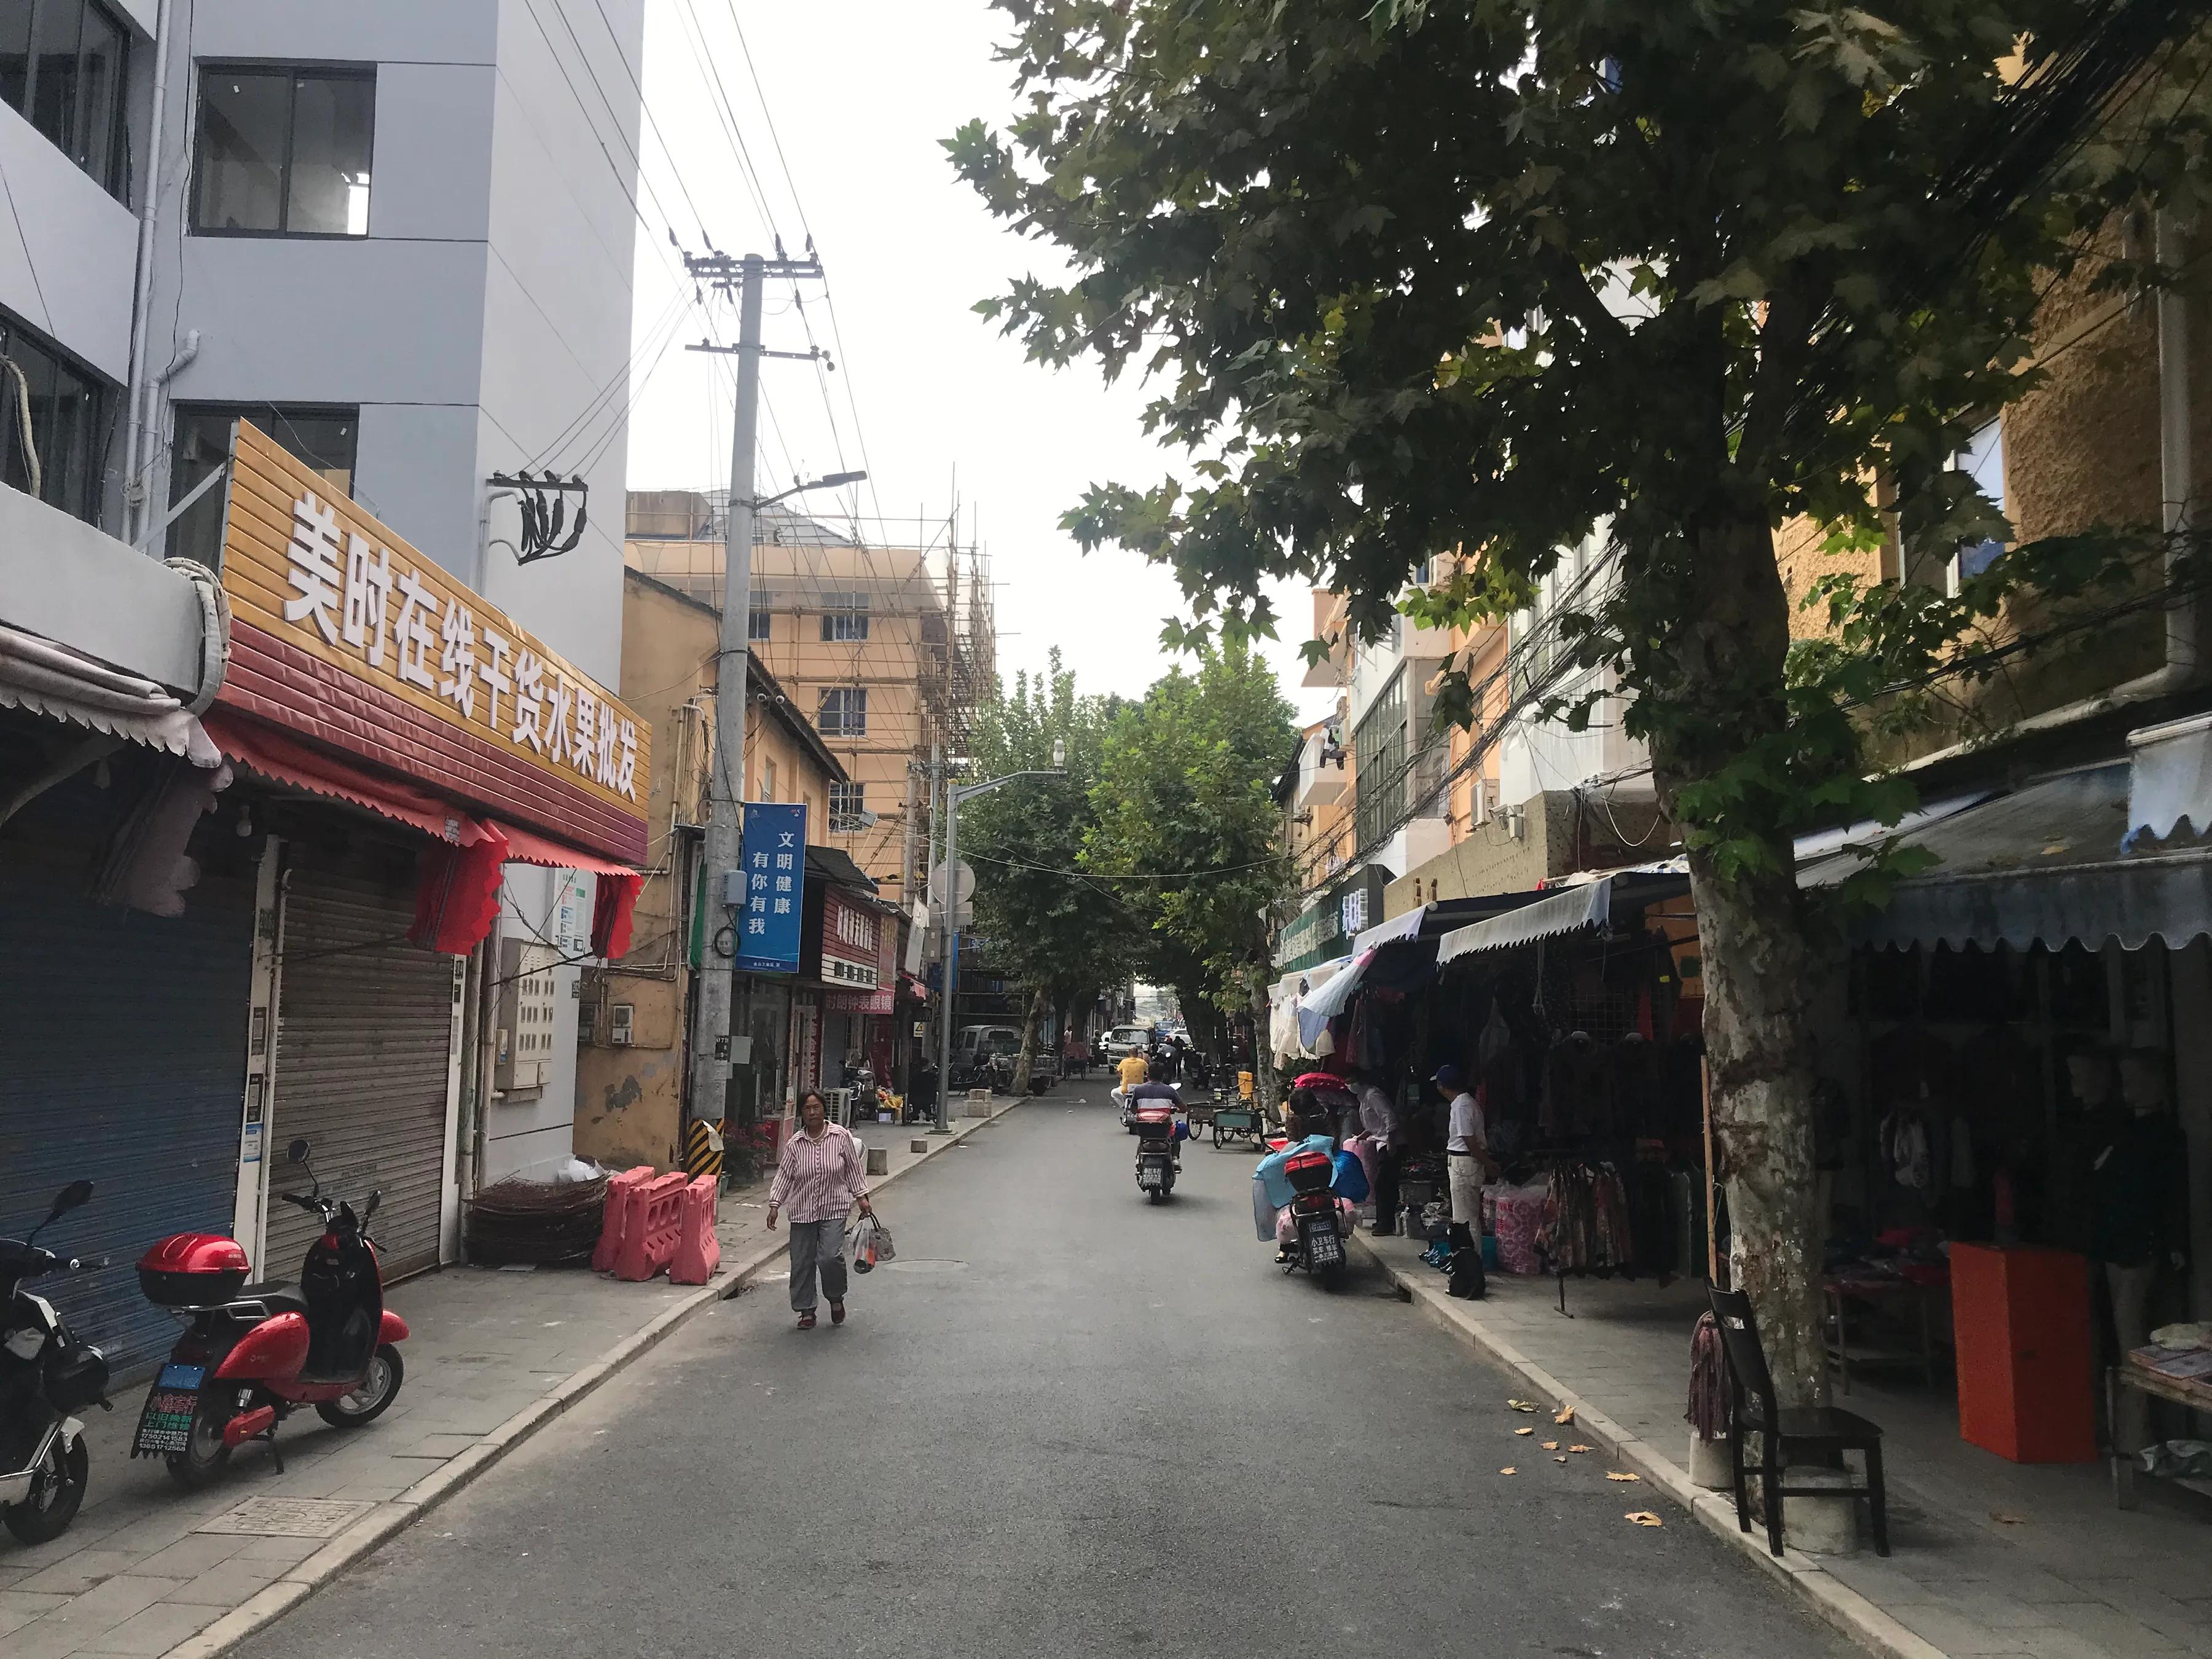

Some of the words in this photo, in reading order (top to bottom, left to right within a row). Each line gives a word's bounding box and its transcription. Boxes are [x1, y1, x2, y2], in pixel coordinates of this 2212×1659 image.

[283, 493, 637, 802] 美时在线干货水果批发
[748, 852, 769, 935] 有你有我
[774, 831, 794, 914] 文明健康
